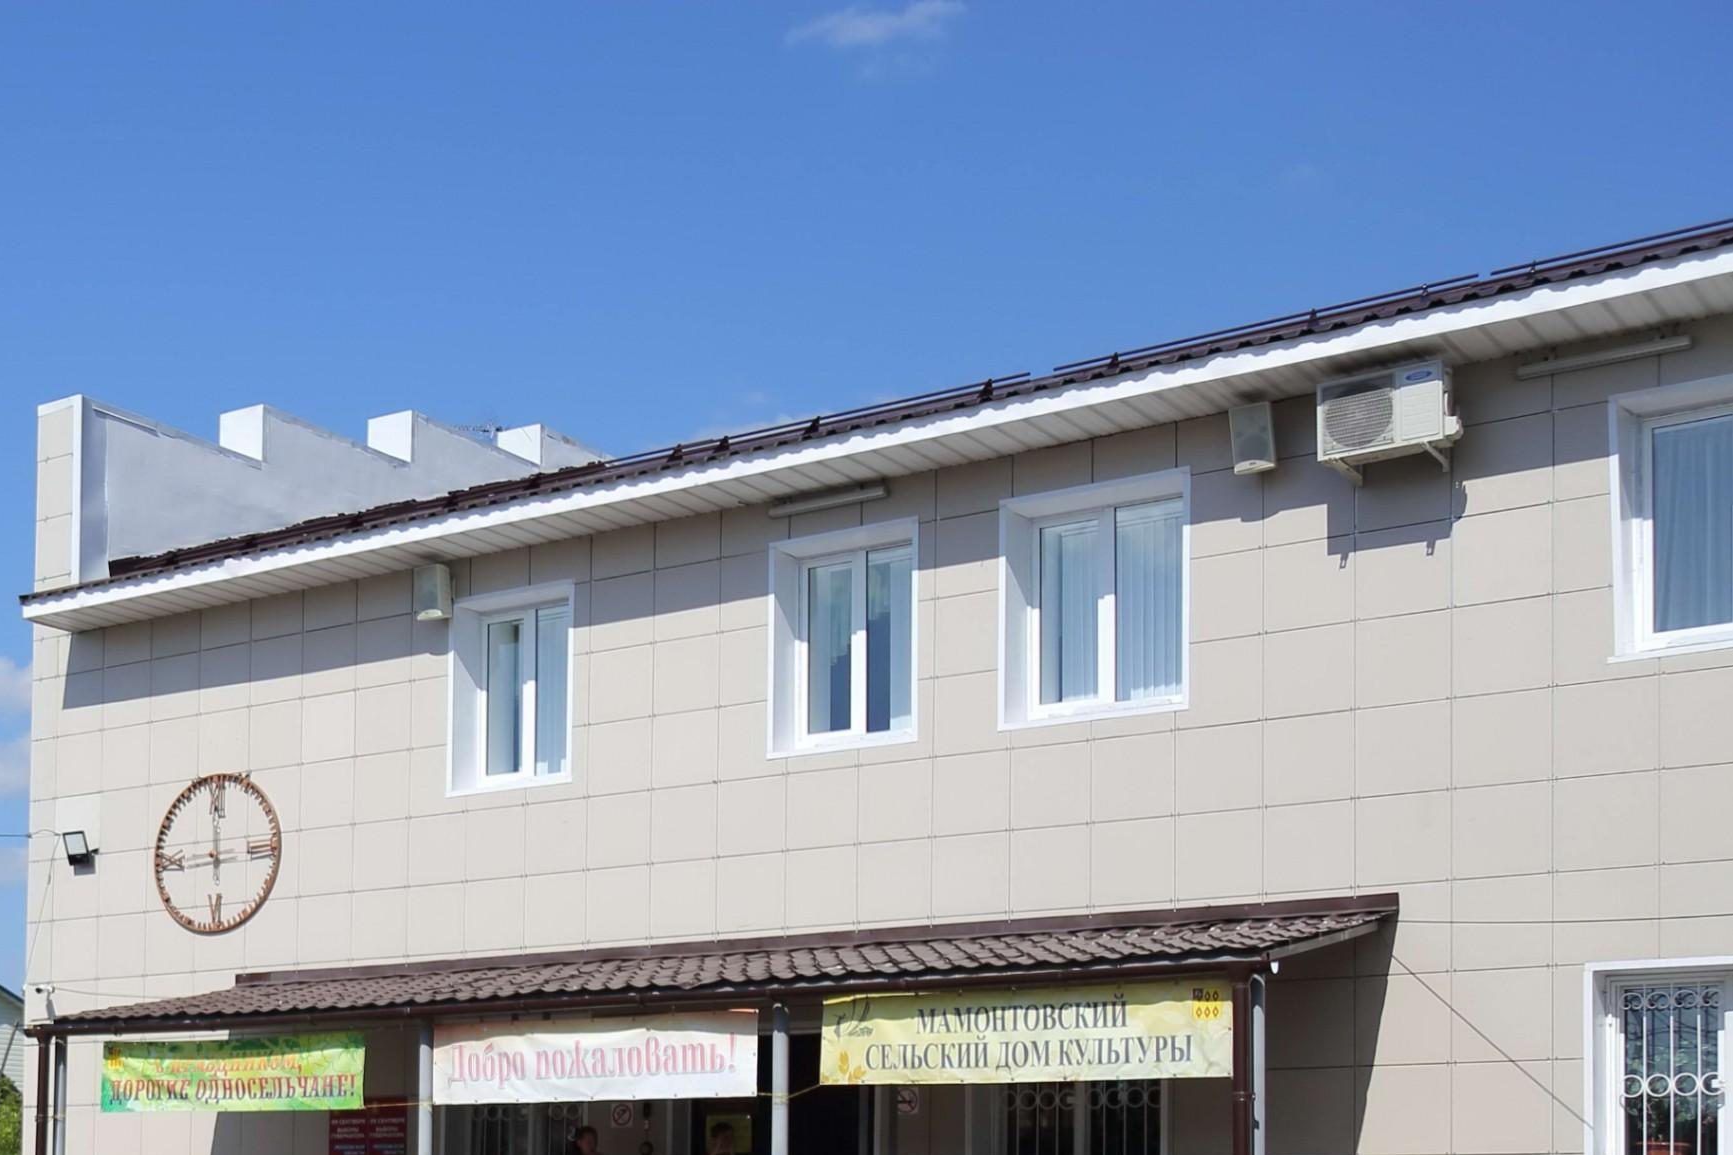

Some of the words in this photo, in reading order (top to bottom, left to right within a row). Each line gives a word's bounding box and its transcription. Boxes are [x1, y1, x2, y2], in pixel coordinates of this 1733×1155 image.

[915, 994, 1128, 1035] МАМОНТОВСКИЙ
[447, 1043, 526, 1089] Добро
[535, 1031, 737, 1081] пожаловать!
[865, 1035, 989, 1071] СЕЛЬСКИЙ
[996, 1040, 1052, 1073] ДОМ
[1058, 1035, 1193, 1070] КУЛЬТУРЫ
[109, 1078, 191, 1105] ДОРОГИЕ
[195, 1073, 357, 1104] ОДНОСЕЛЬЧАНЕ!
